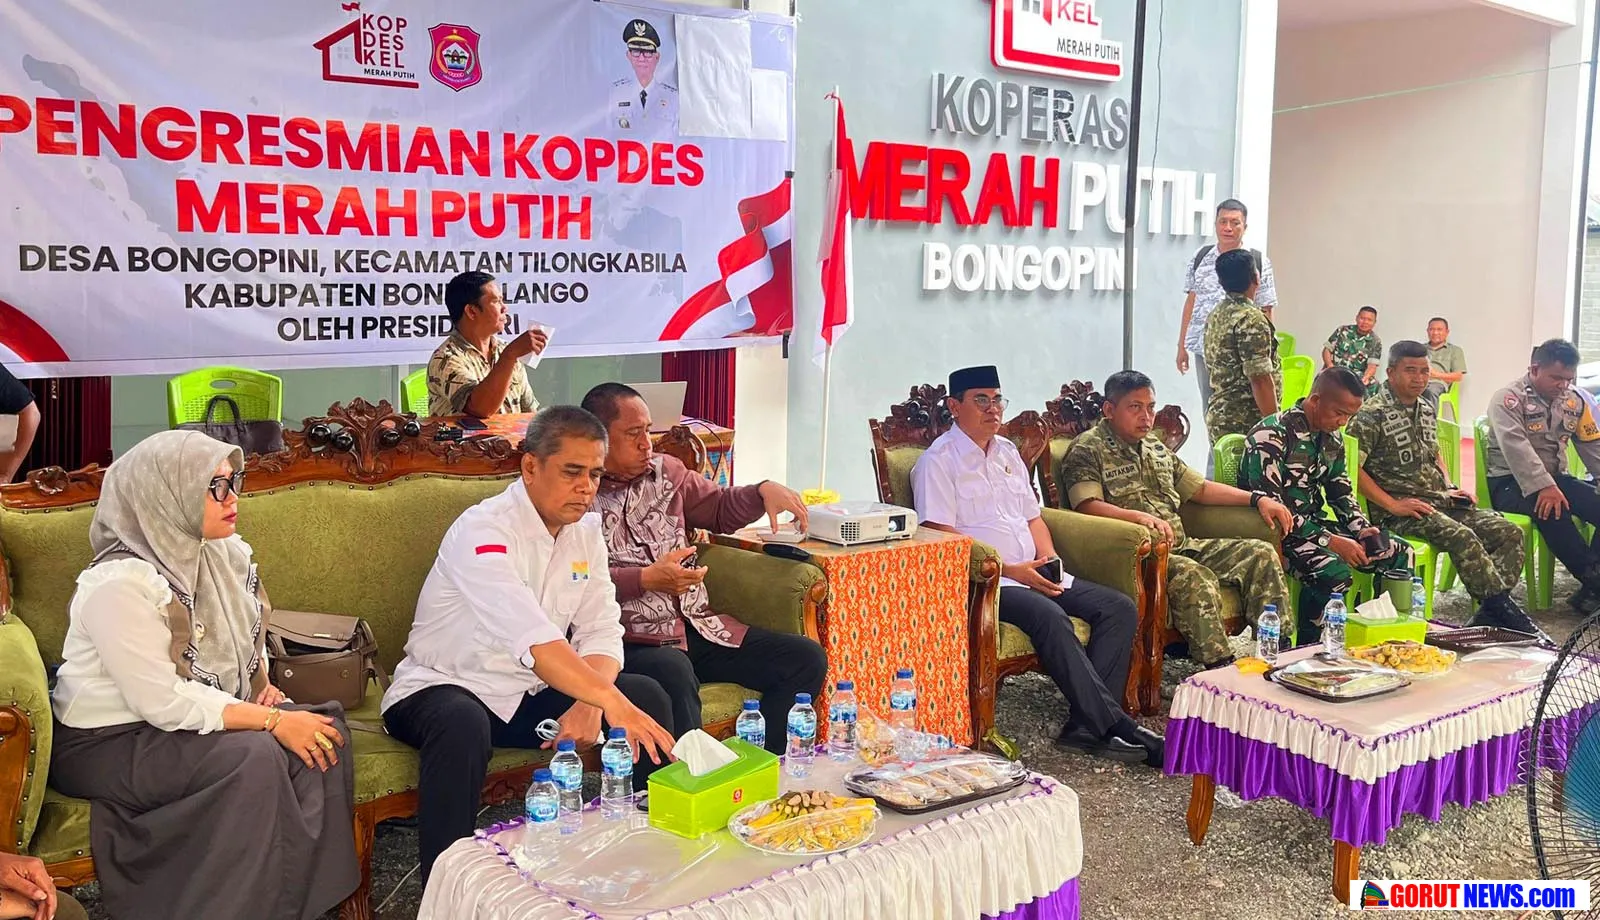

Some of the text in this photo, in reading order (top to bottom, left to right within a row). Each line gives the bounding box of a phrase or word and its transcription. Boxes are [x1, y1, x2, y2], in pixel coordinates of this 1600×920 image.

[362, 12, 408, 33] KOP
[1057, 0, 1099, 26] KEL
[362, 31, 404, 51] DES
[1057, 37, 1120, 61] MERAH PUTIH
[363, 49, 405, 69] KEL
[364, 67, 415, 80] MERAH PUTIH
[930, 72, 1130, 151] KOPERAS
[0, 94, 705, 187] PENGRESMIAN KOPDES
[841, 136, 1217, 237] MERAH PUTIH
[176, 179, 592, 240] MERAH PUTIH
[19, 244, 688, 277] DESA BONGOPINI, KECAMATAN TILONGKABILA
[184, 282, 589, 309] KABUPATEN BON LANGO
[277, 316, 354, 342] OLEH
[361, 314, 455, 339] PRESID
